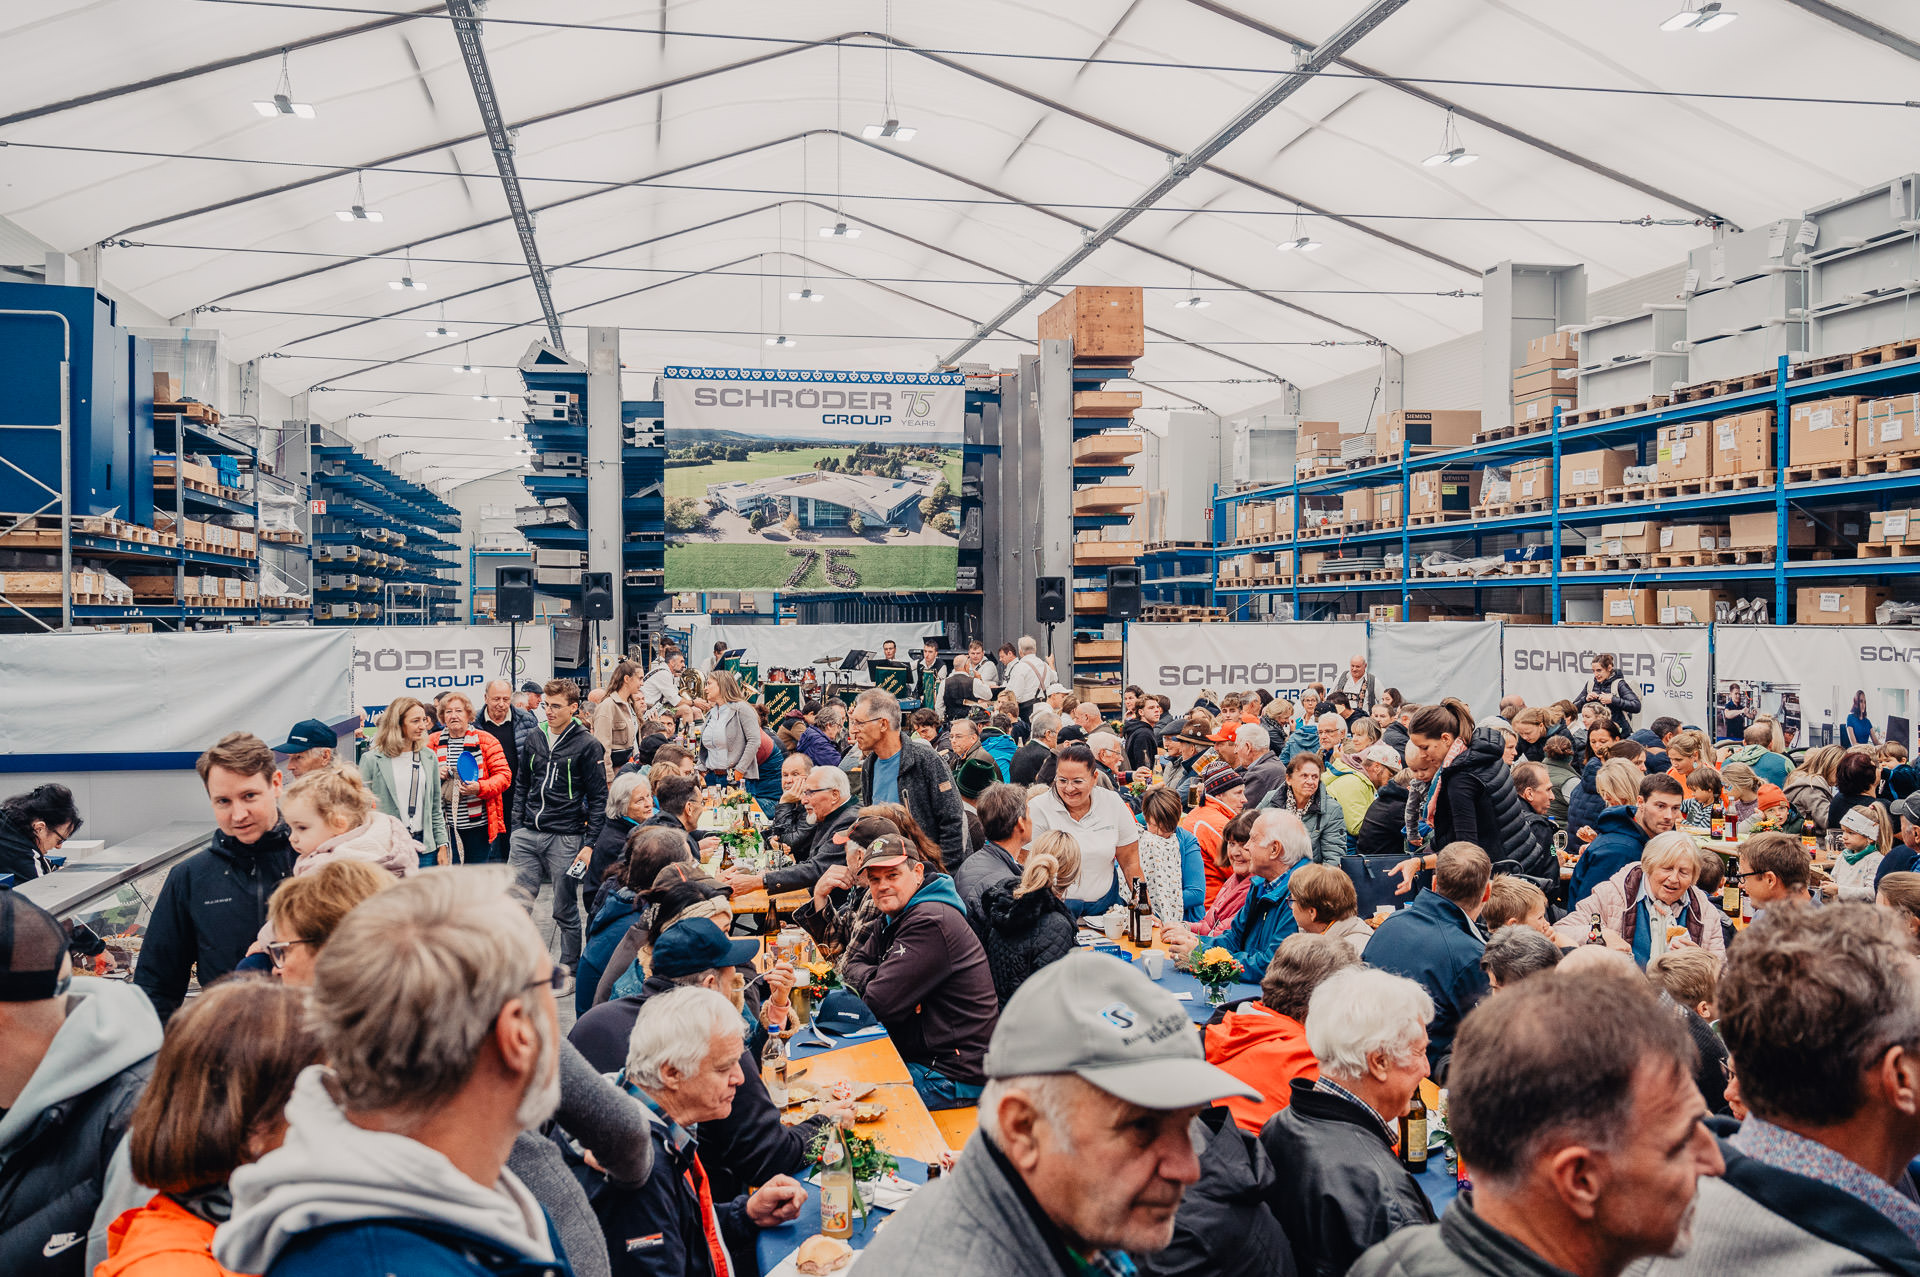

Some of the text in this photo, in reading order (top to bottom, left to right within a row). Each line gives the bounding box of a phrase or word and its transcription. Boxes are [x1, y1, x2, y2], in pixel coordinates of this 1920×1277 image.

[694, 387, 892, 410] SCHRÖDER
[900, 390, 936, 418] 75
[822, 414, 892, 426] GROUP
[901, 419, 936, 427] YEARS
[783, 548, 861, 590] 75
[493, 646, 532, 676] 75
[1660, 652, 1694, 688] 75
[405, 674, 484, 689] GROUP
[1159, 662, 1338, 686] SCHRÖDER
[1663, 689, 1693, 700] YEARS
